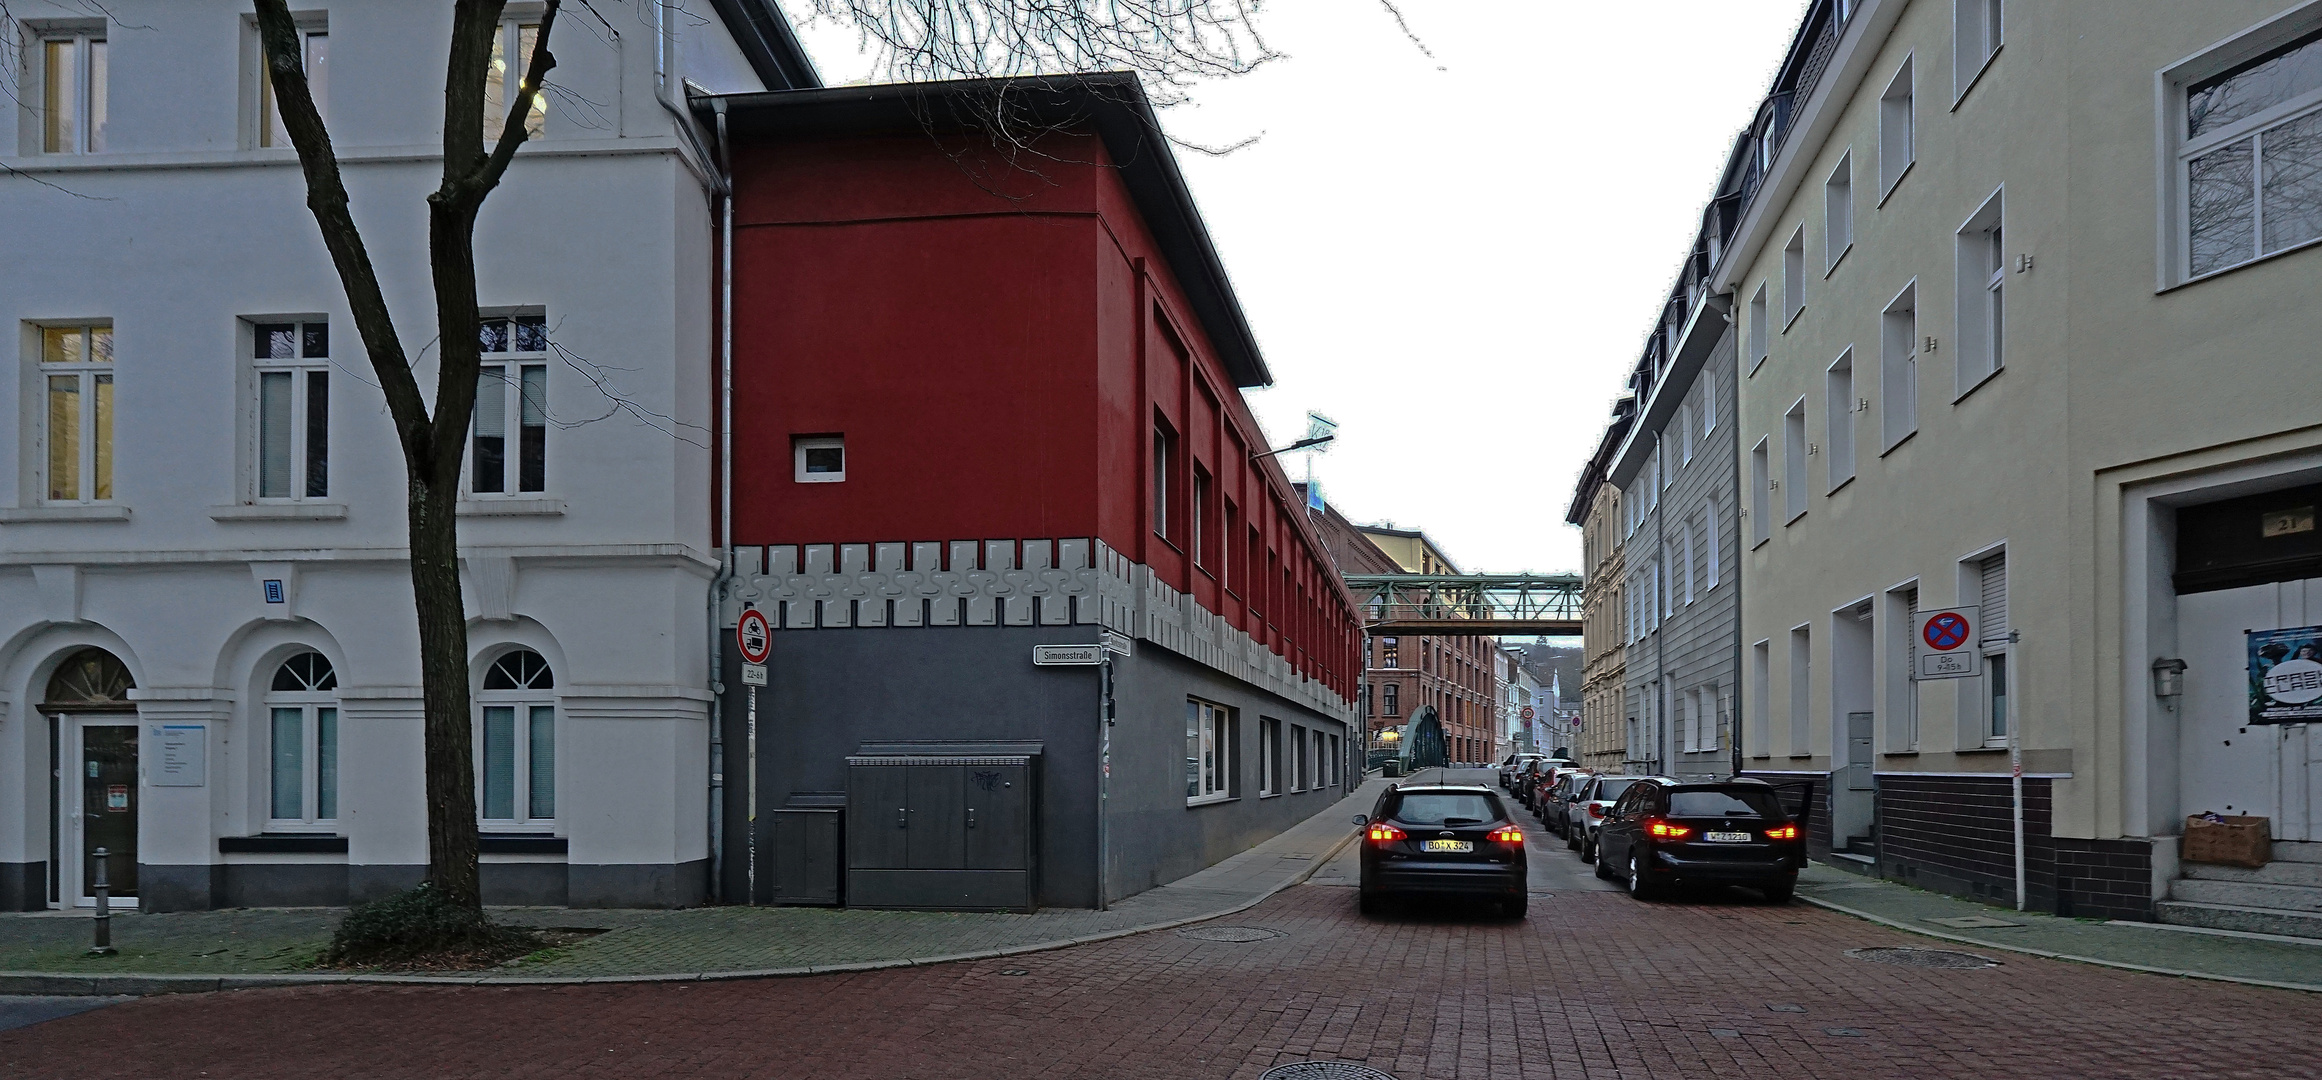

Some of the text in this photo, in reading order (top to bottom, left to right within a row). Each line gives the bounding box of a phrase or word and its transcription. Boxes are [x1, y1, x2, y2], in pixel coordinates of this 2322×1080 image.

[2278, 517, 2297, 531] 21
[1044, 650, 1092, 660] Simonsstraße
[1941, 656, 1953, 664] Do
[2264, 680, 2322, 695] CLAS
[1428, 841, 1469, 851] BO X 324
